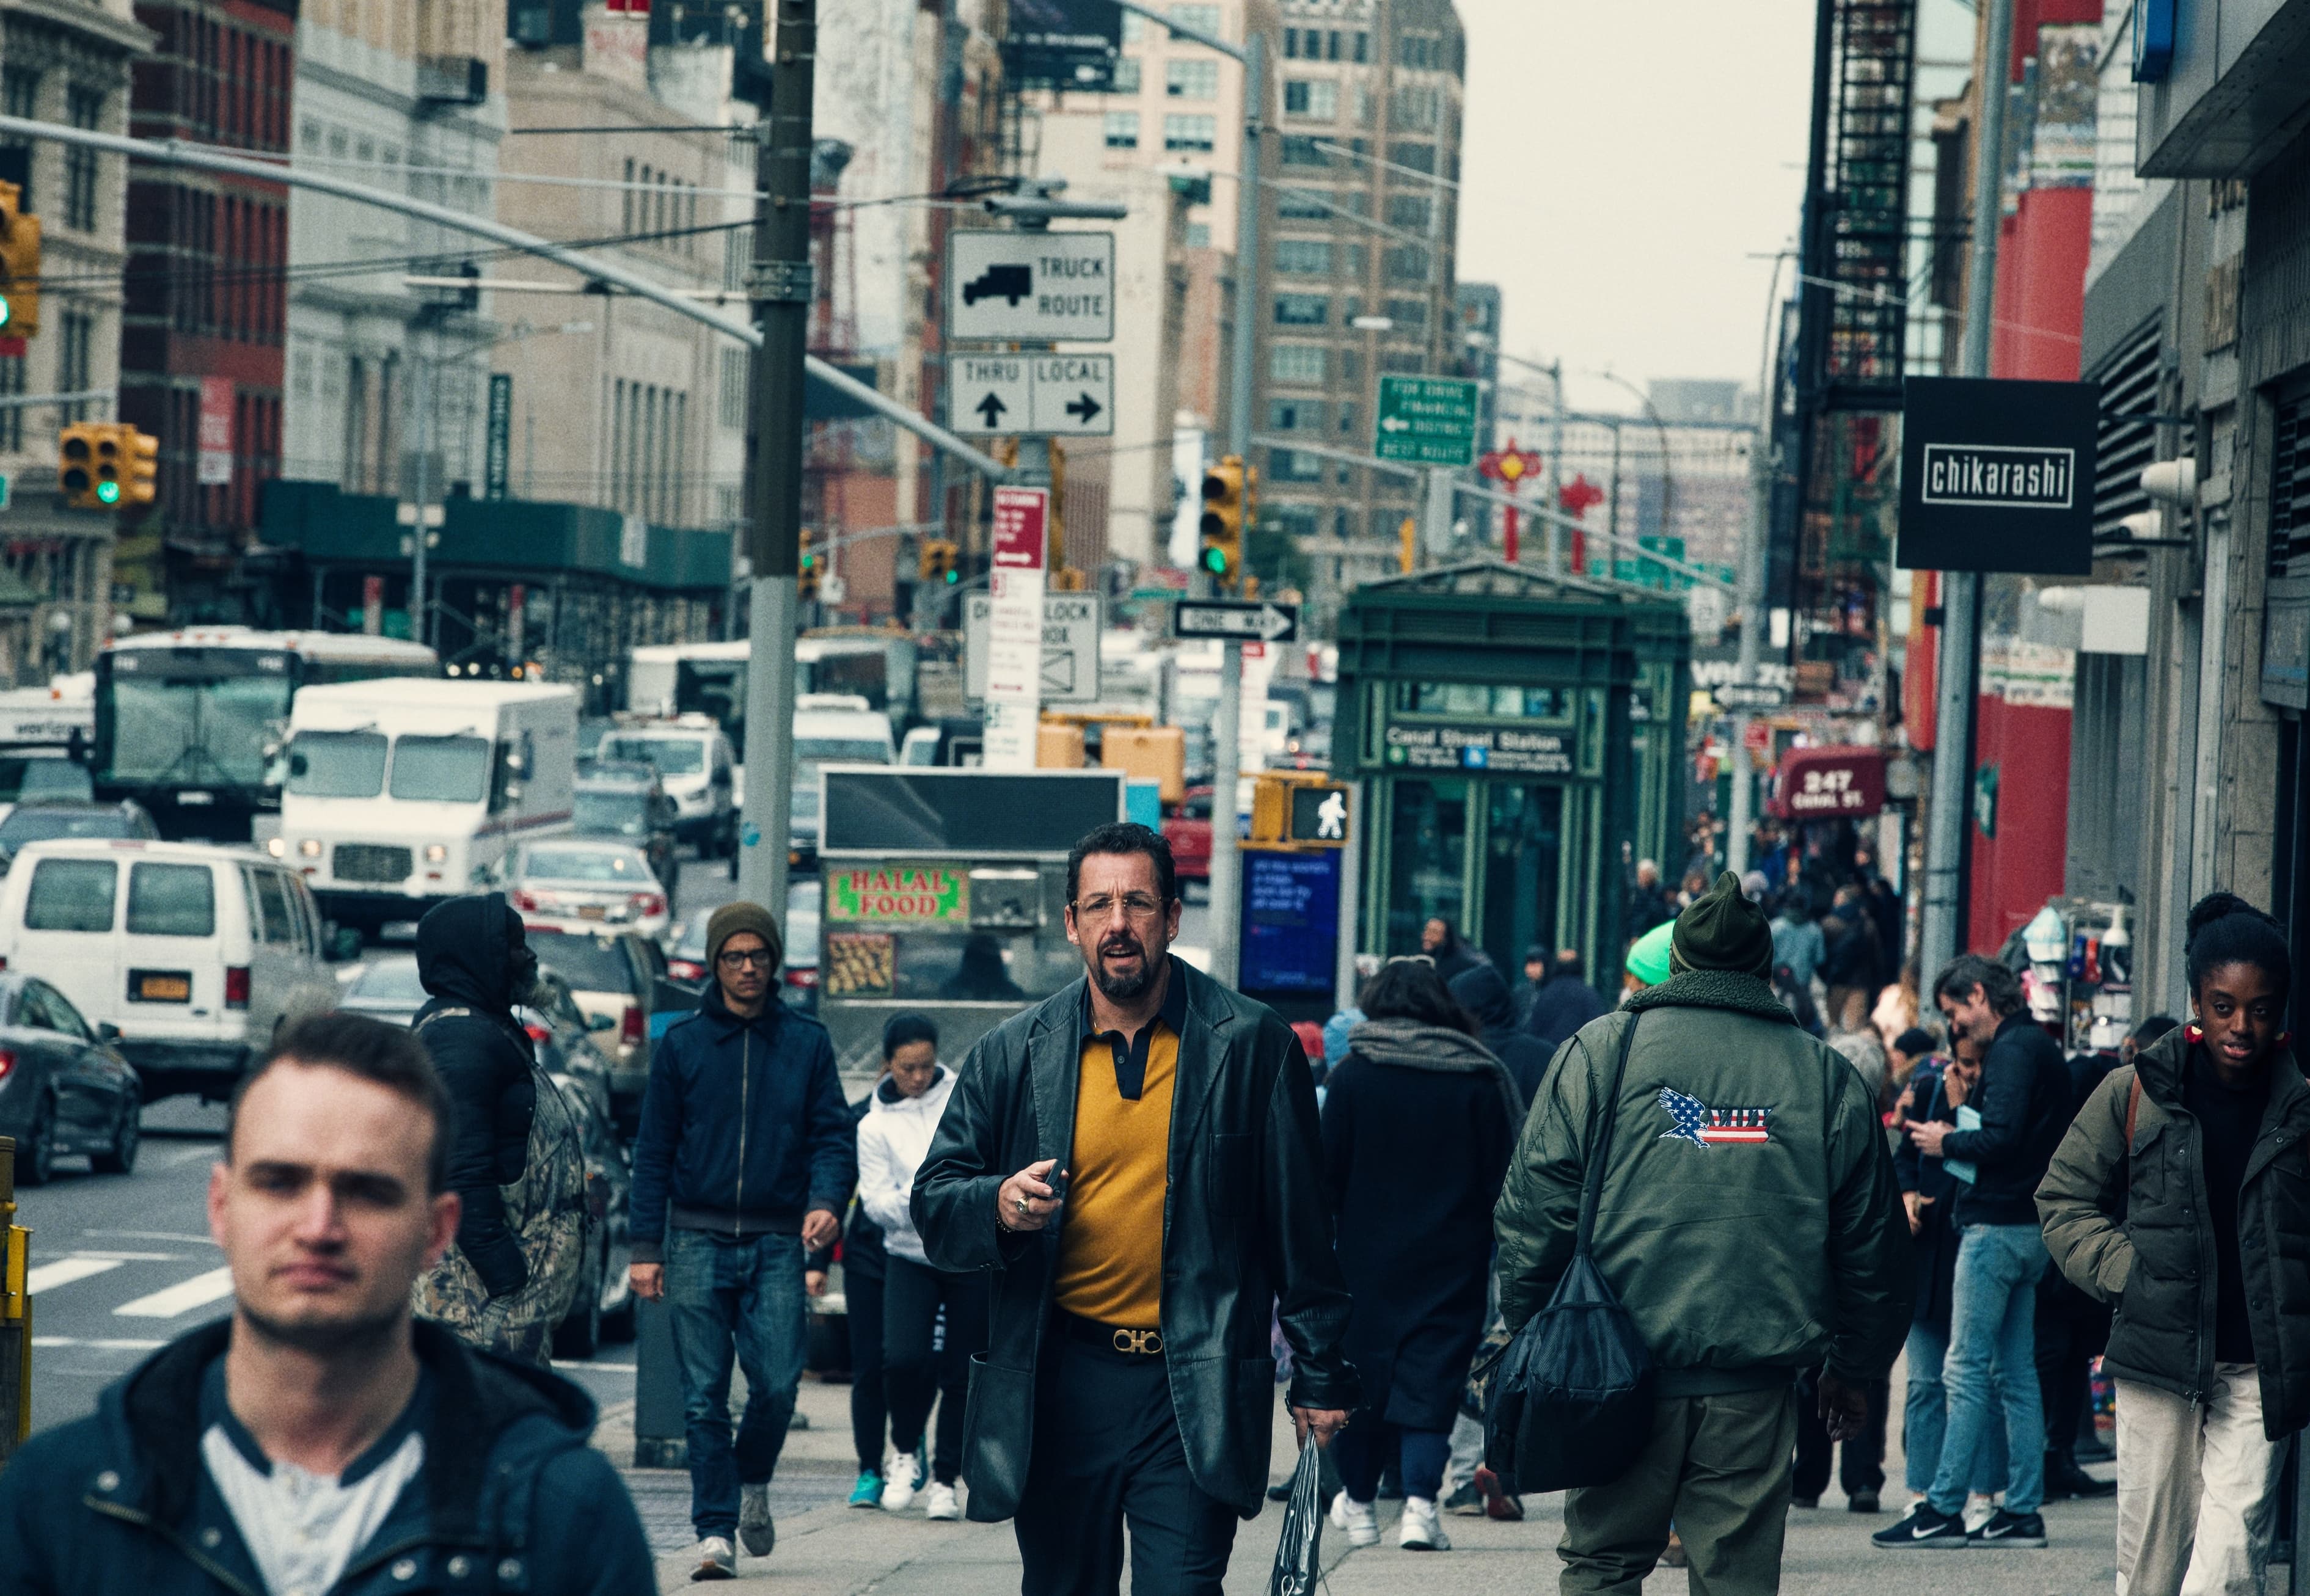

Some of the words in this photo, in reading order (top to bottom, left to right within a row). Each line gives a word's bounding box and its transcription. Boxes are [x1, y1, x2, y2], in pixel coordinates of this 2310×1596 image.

[1040, 257, 1103, 277] TRUCK
[1039, 295, 1103, 316] ROUTE
[965, 362, 1020, 382] THRU
[1039, 362, 1103, 382] LOCAL
[1932, 455, 2065, 497] chikarashi
[1044, 601, 1089, 621] LOCK
[1193, 612, 1223, 630] ONE
[1387, 727, 1436, 746] Canal
[1440, 729, 1493, 749] Street
[1499, 732, 1561, 751] Station
[1804, 770, 1853, 793] 247
[851, 870, 949, 892] HALAL
[860, 895, 937, 915] FOOD
[1708, 1109, 1772, 1128] NAVY
